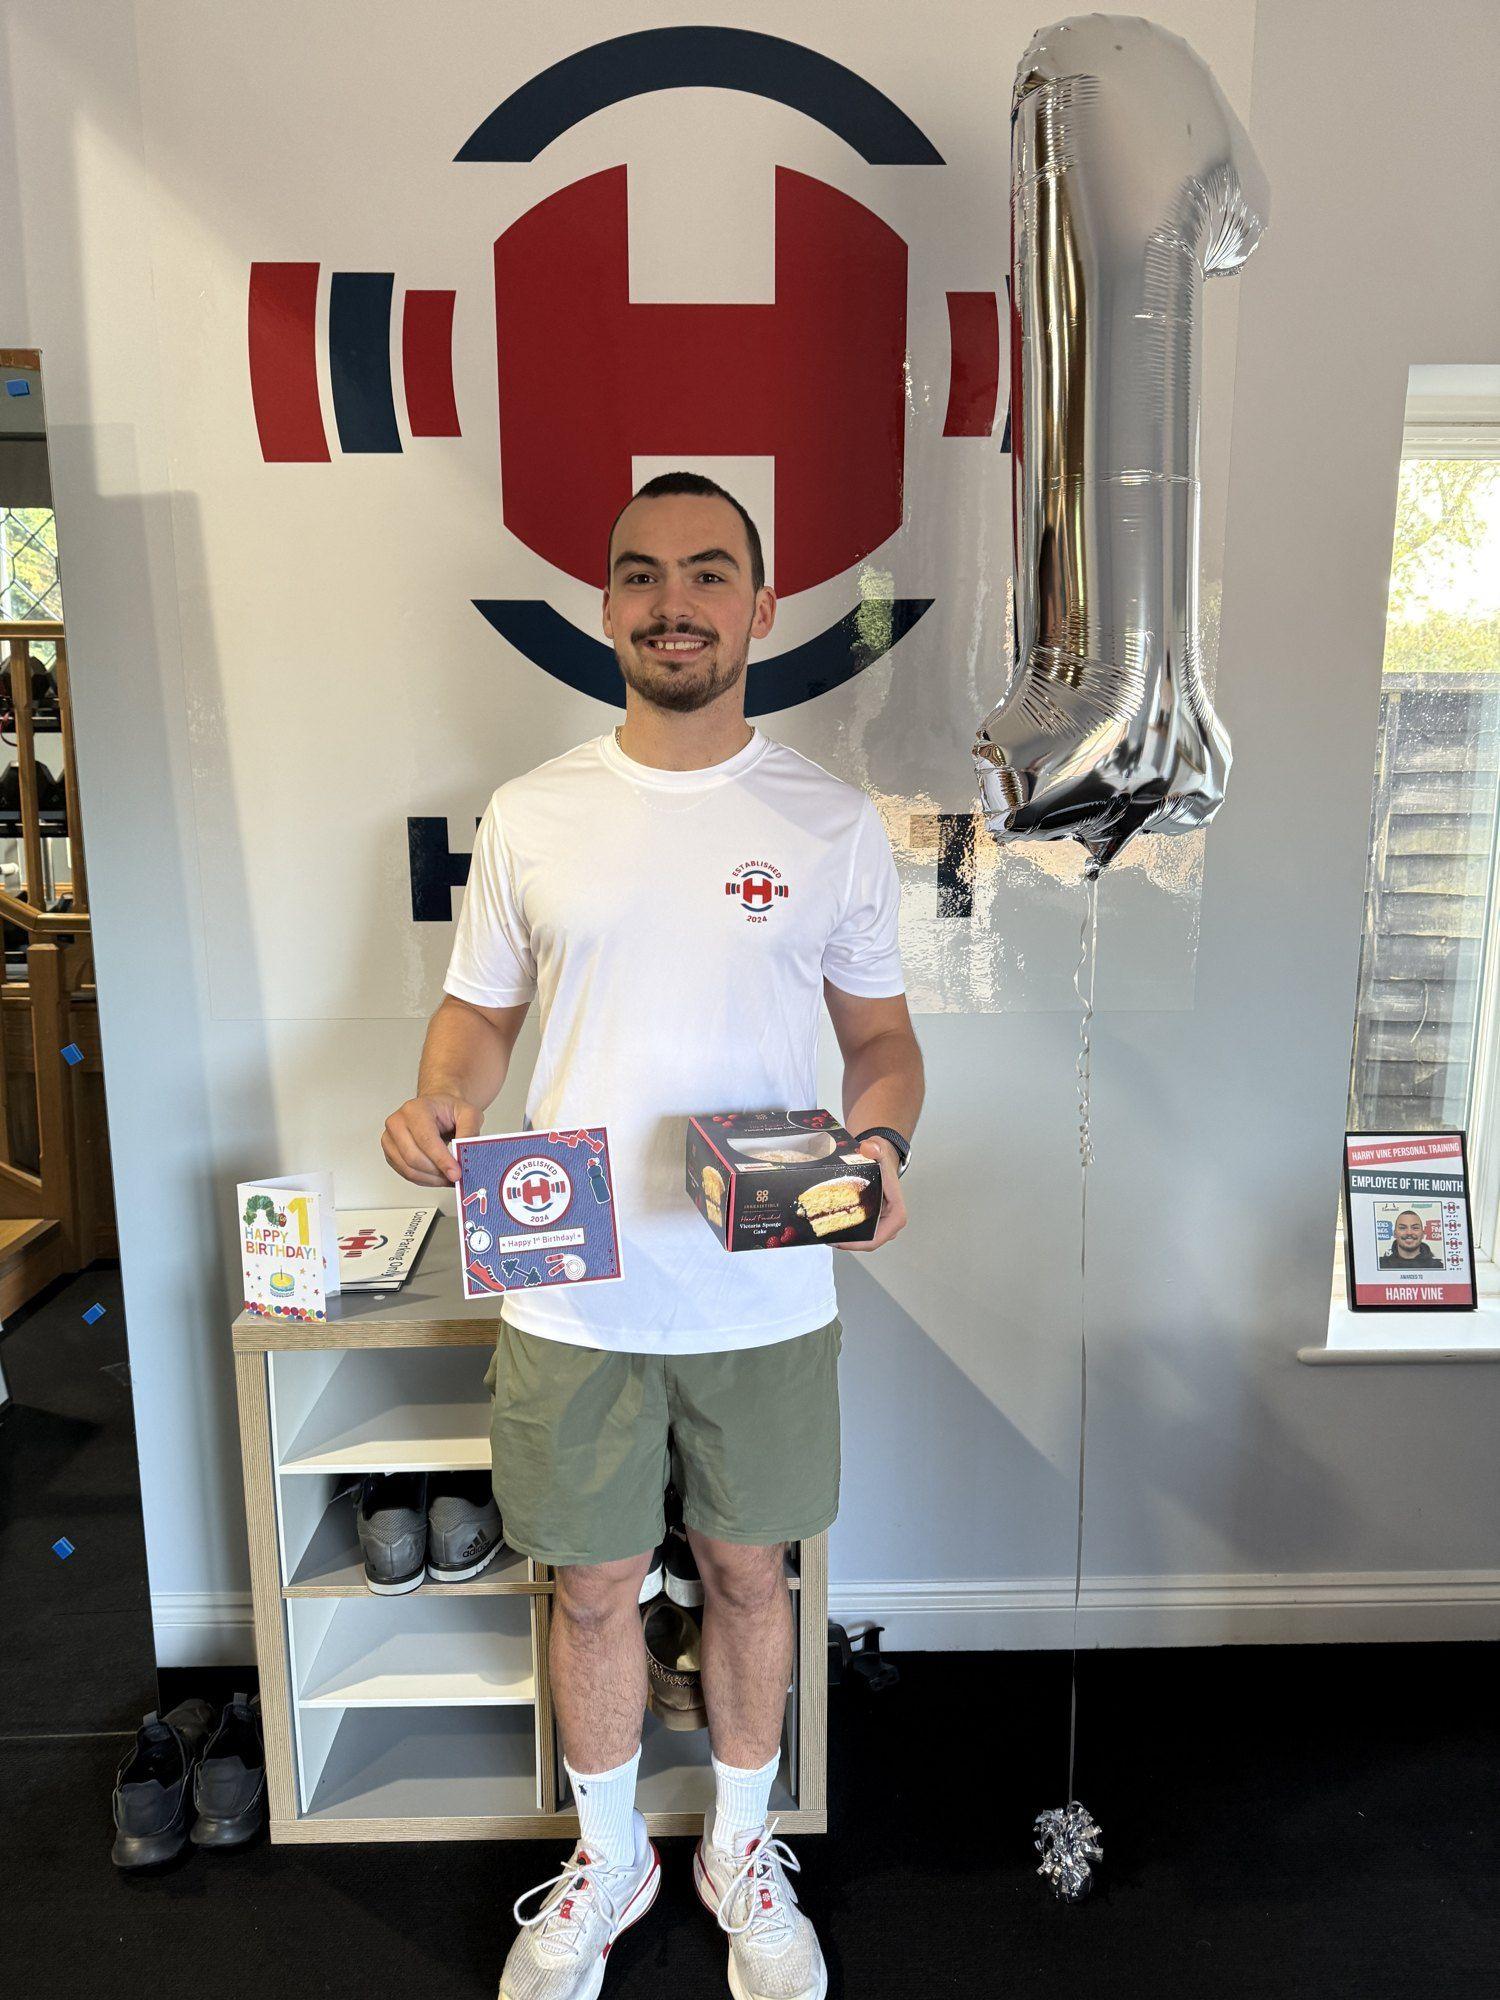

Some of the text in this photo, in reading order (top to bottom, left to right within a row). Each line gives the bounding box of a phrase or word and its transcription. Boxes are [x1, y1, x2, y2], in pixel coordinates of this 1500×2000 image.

[494, 164, 908, 599] H
[732, 860, 782, 879] ESTABLISHED
[746, 915, 768, 923] 2024
[1352, 1142, 1459, 1161] HARRY VINE PERSONAL TRAINING
[512, 1161, 558, 1181] ESTABLISHED
[1351, 1175, 1464, 1193] EMPLOYEE OF THE MONTH
[530, 1214, 550, 1223] 2024
[245, 1226, 288, 1243] HAPPY
[508, 1240, 531, 1249] Happy
[542, 1233, 576, 1244] Birthday!
[246, 1240, 316, 1261] BIRTHDAY!
[381, 1210, 427, 1278] Customer Parking Only
[1385, 1287, 1444, 1301] HARRY VINE
